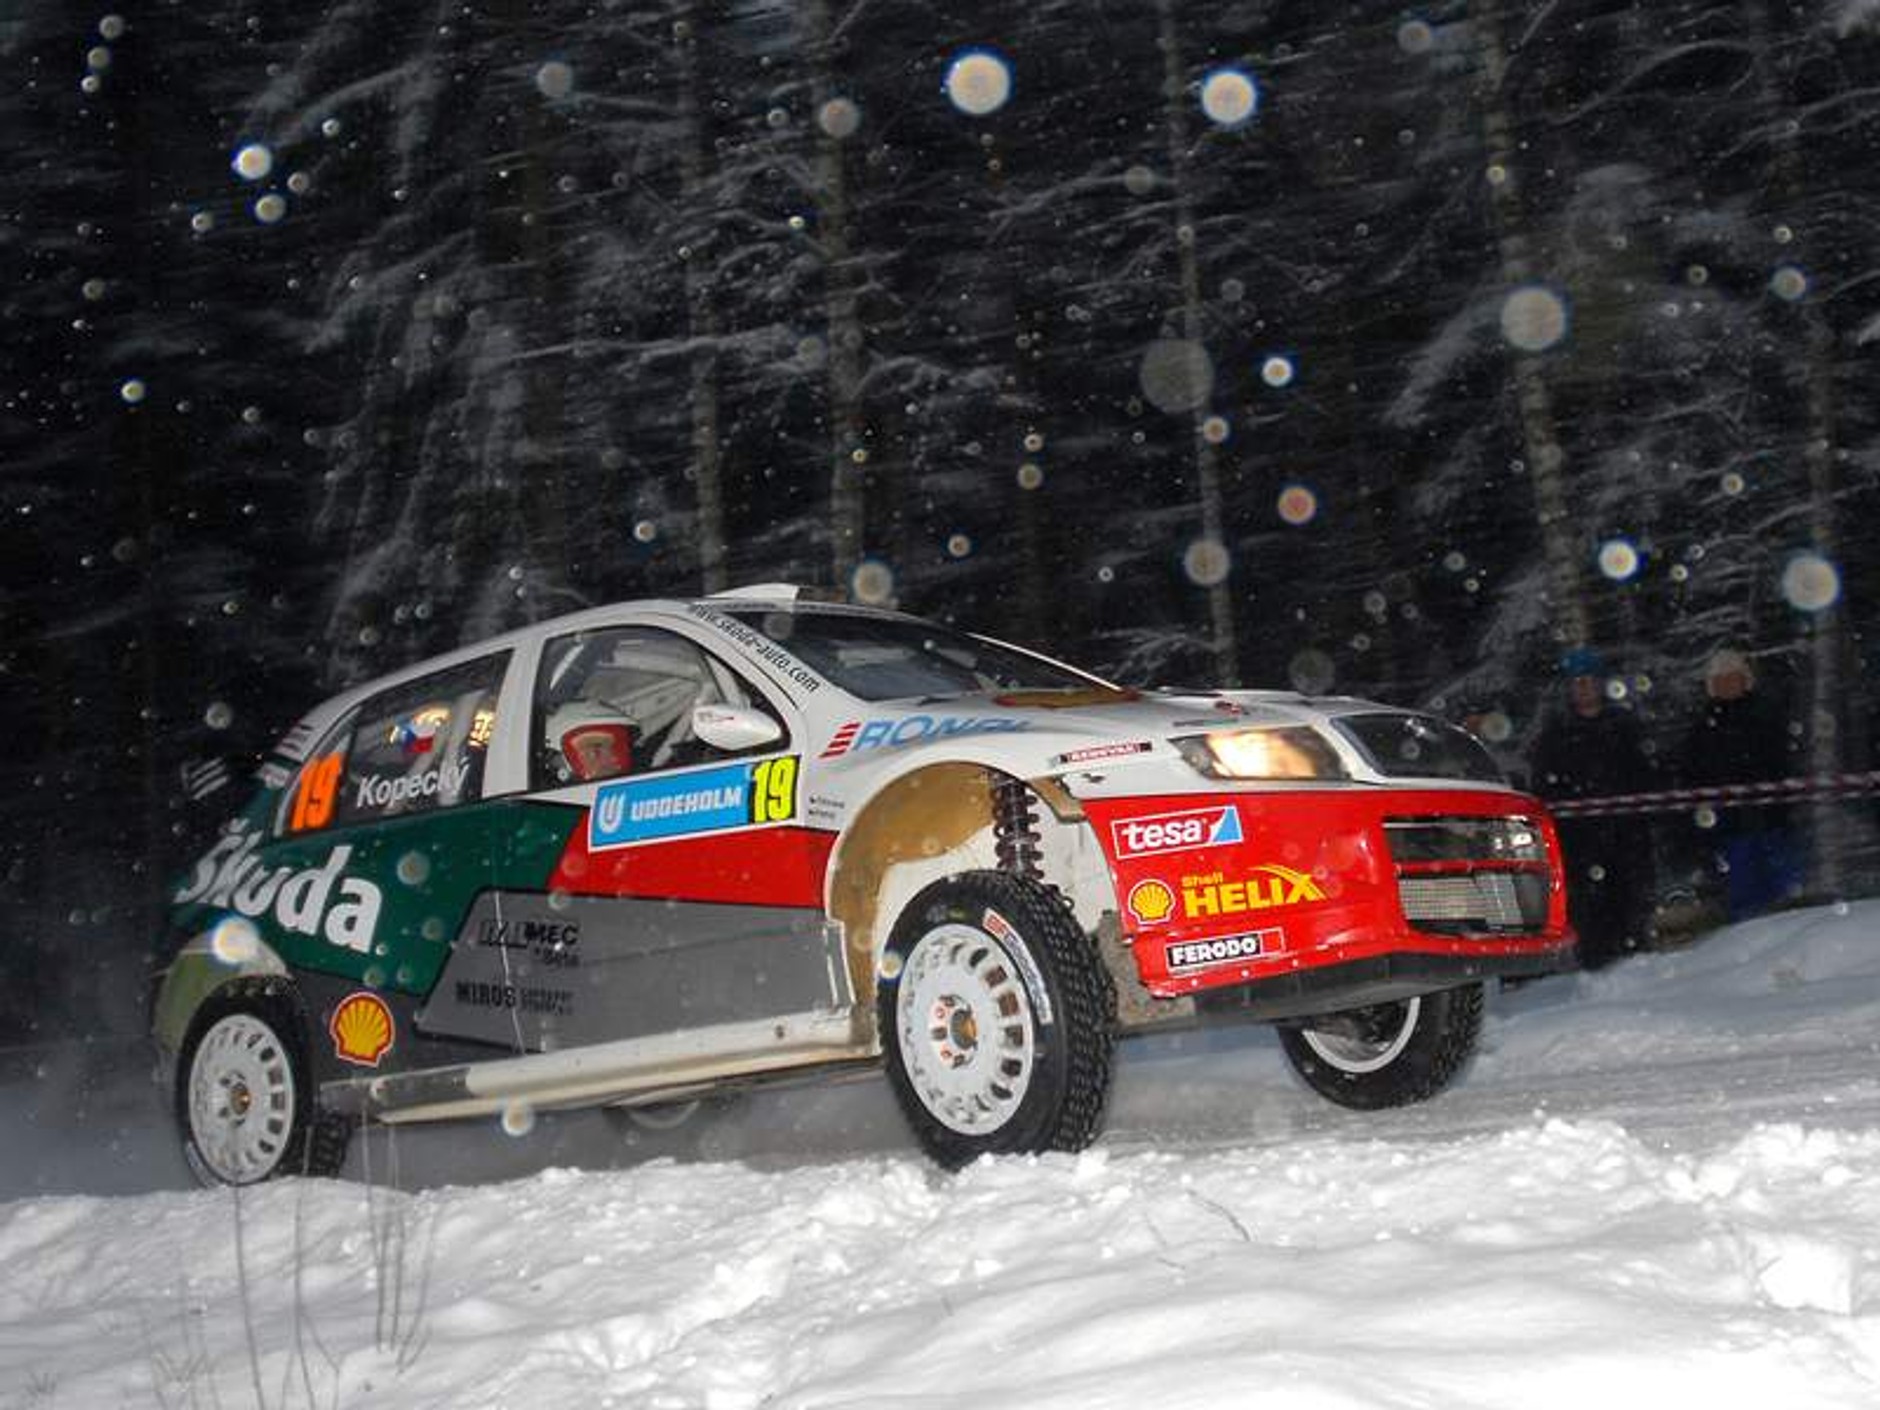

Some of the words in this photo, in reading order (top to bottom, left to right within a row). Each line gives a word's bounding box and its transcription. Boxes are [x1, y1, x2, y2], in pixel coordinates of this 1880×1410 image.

[291, 751, 342, 830] 19
[356, 756, 470, 809] Kopecký
[630, 786, 742, 822] UDDEHOLM
[754, 755, 796, 823] 19
[1121, 818, 1203, 851] tesa
[1182, 866, 1326, 918] HELIX
[1172, 936, 1258, 966] FERODO
